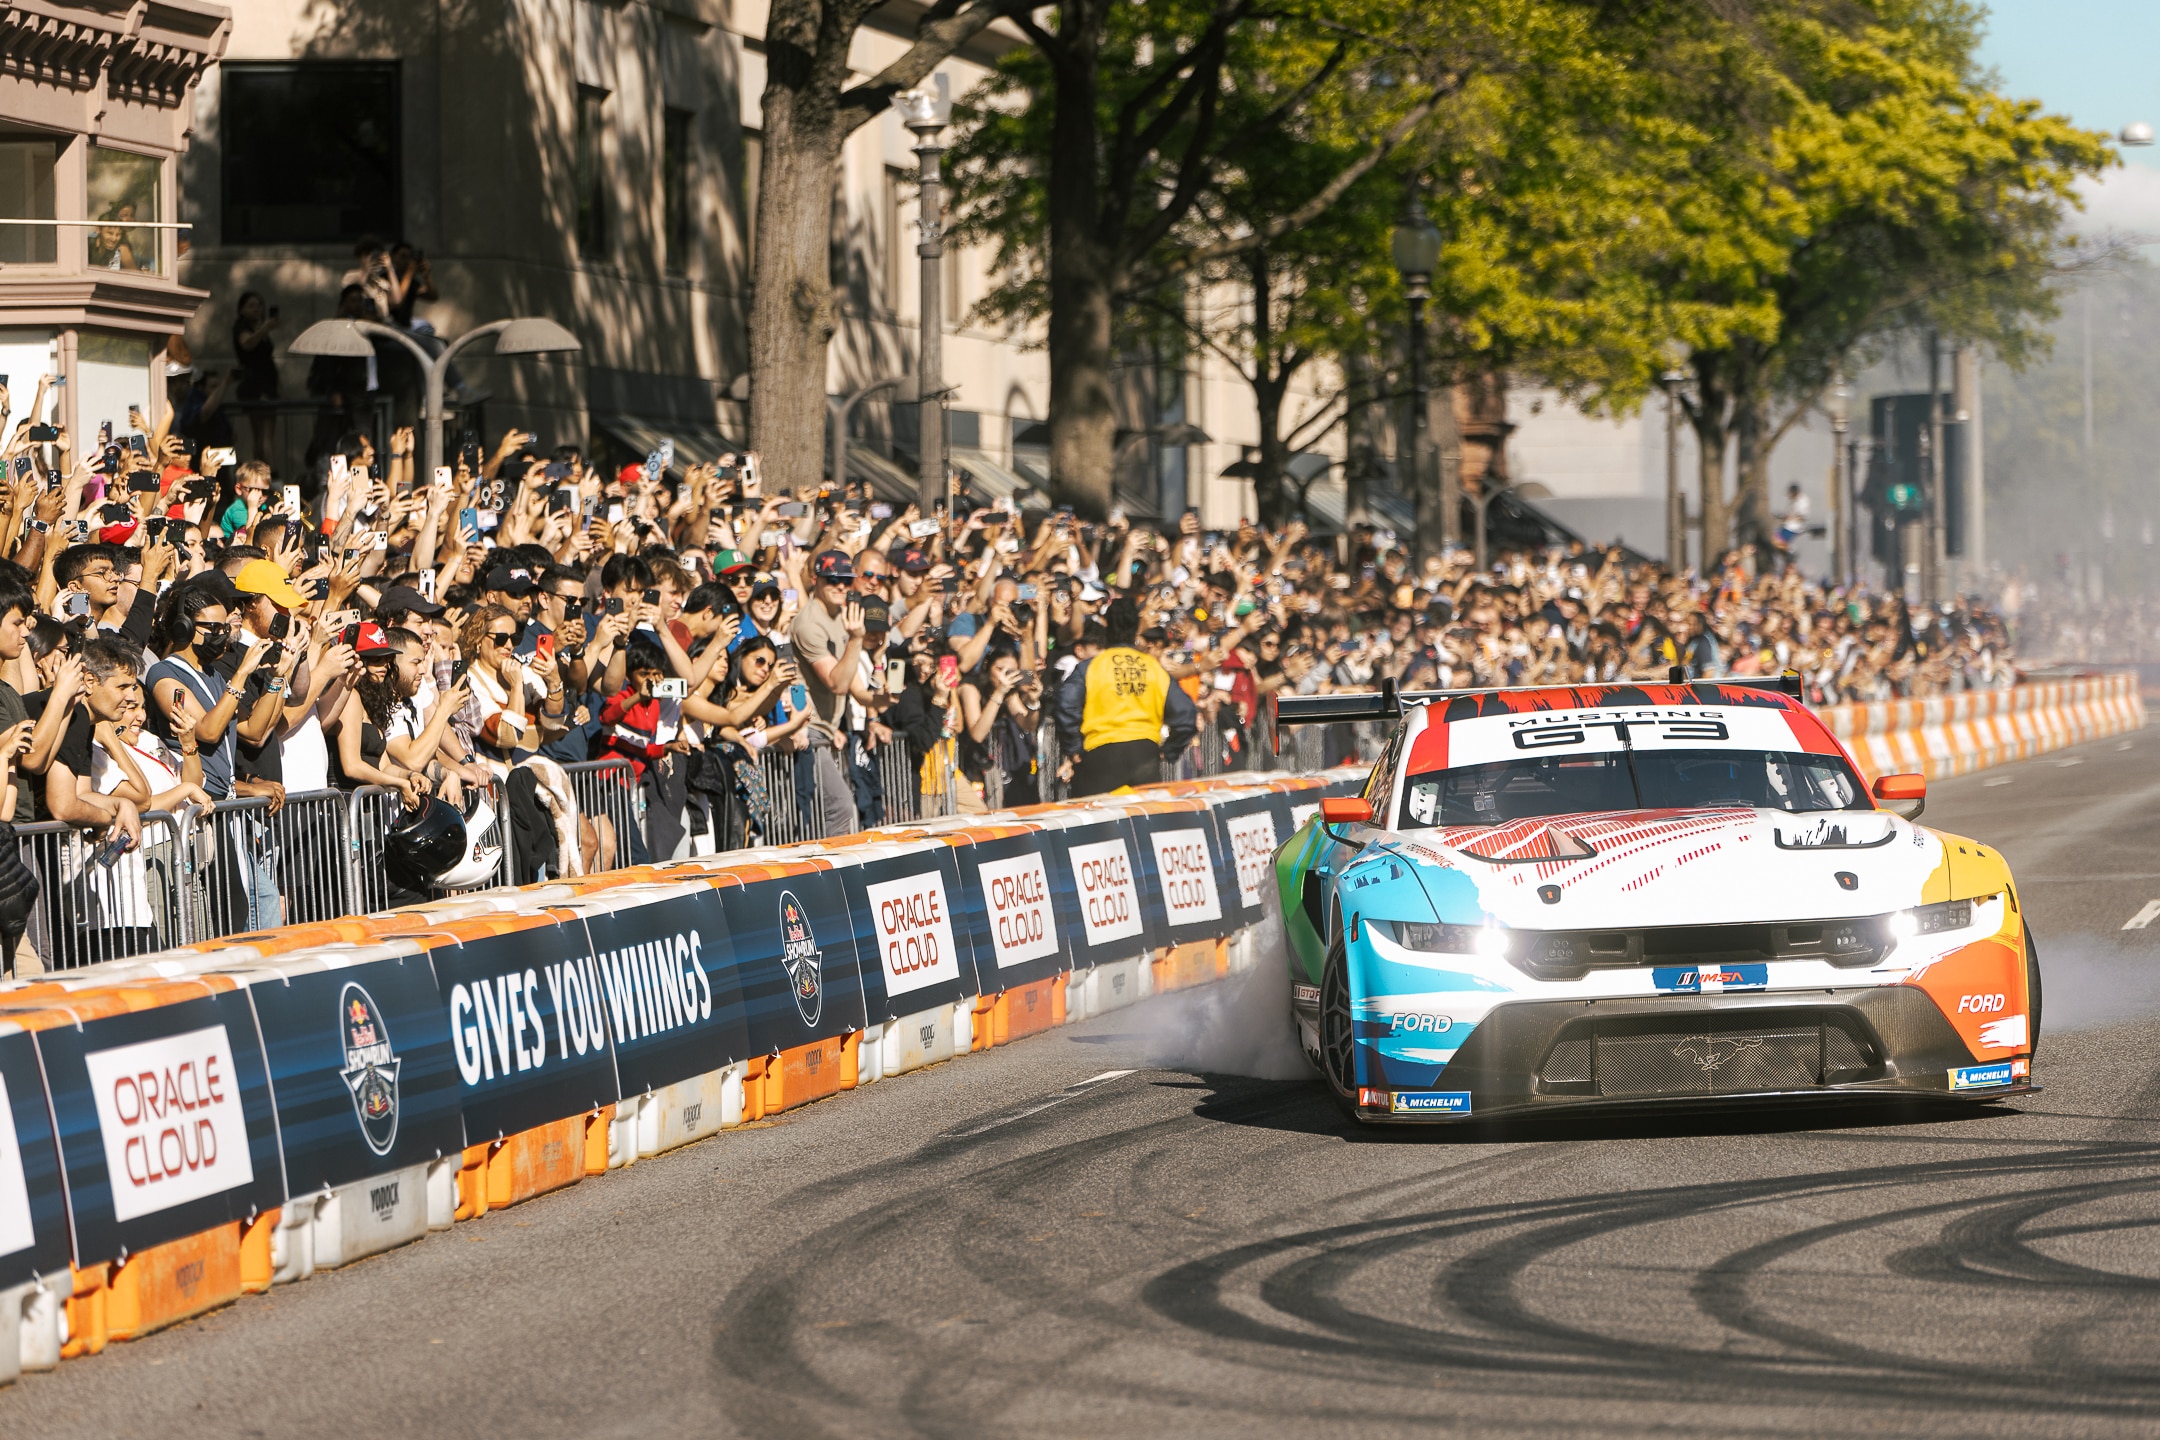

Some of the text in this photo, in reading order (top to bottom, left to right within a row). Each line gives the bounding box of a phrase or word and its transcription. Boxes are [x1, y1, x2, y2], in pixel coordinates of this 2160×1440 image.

[1113, 667, 1147, 681] EVENT
[1116, 682, 1147, 696] STAFF
[1509, 711, 1724, 727] MUSTANG
[1512, 720, 1729, 749] GT3
[1234, 827, 1272, 860] ORACLE
[1081, 855, 1129, 891] ORACLE
[1161, 844, 1206, 876] ORACLE
[991, 870, 1044, 911] ORACLE
[1168, 878, 1207, 909] CLOUD
[881, 890, 941, 935] ORACLE
[1088, 892, 1129, 928] CLOUD
[999, 909, 1044, 949] CLOUD
[889, 932, 939, 976] CLOUD
[1698, 972, 1744, 983] IMSA
[450, 929, 712, 1086] GIVES YOU WIIINGS
[1957, 993, 2006, 1014] FORD
[1390, 1013, 1453, 1034] FORD
[347, 1042, 391, 1073] SHOWRUN
[114, 1055, 224, 1126] ORACLE
[1969, 1069, 2010, 1082] MICHELIN
[1362, 1090, 1390, 1106] MOTUL
[1409, 1097, 1463, 1107] MICHELIN
[125, 1118, 217, 1187] CLOUD
[370, 1181, 400, 1213] YODOCK
